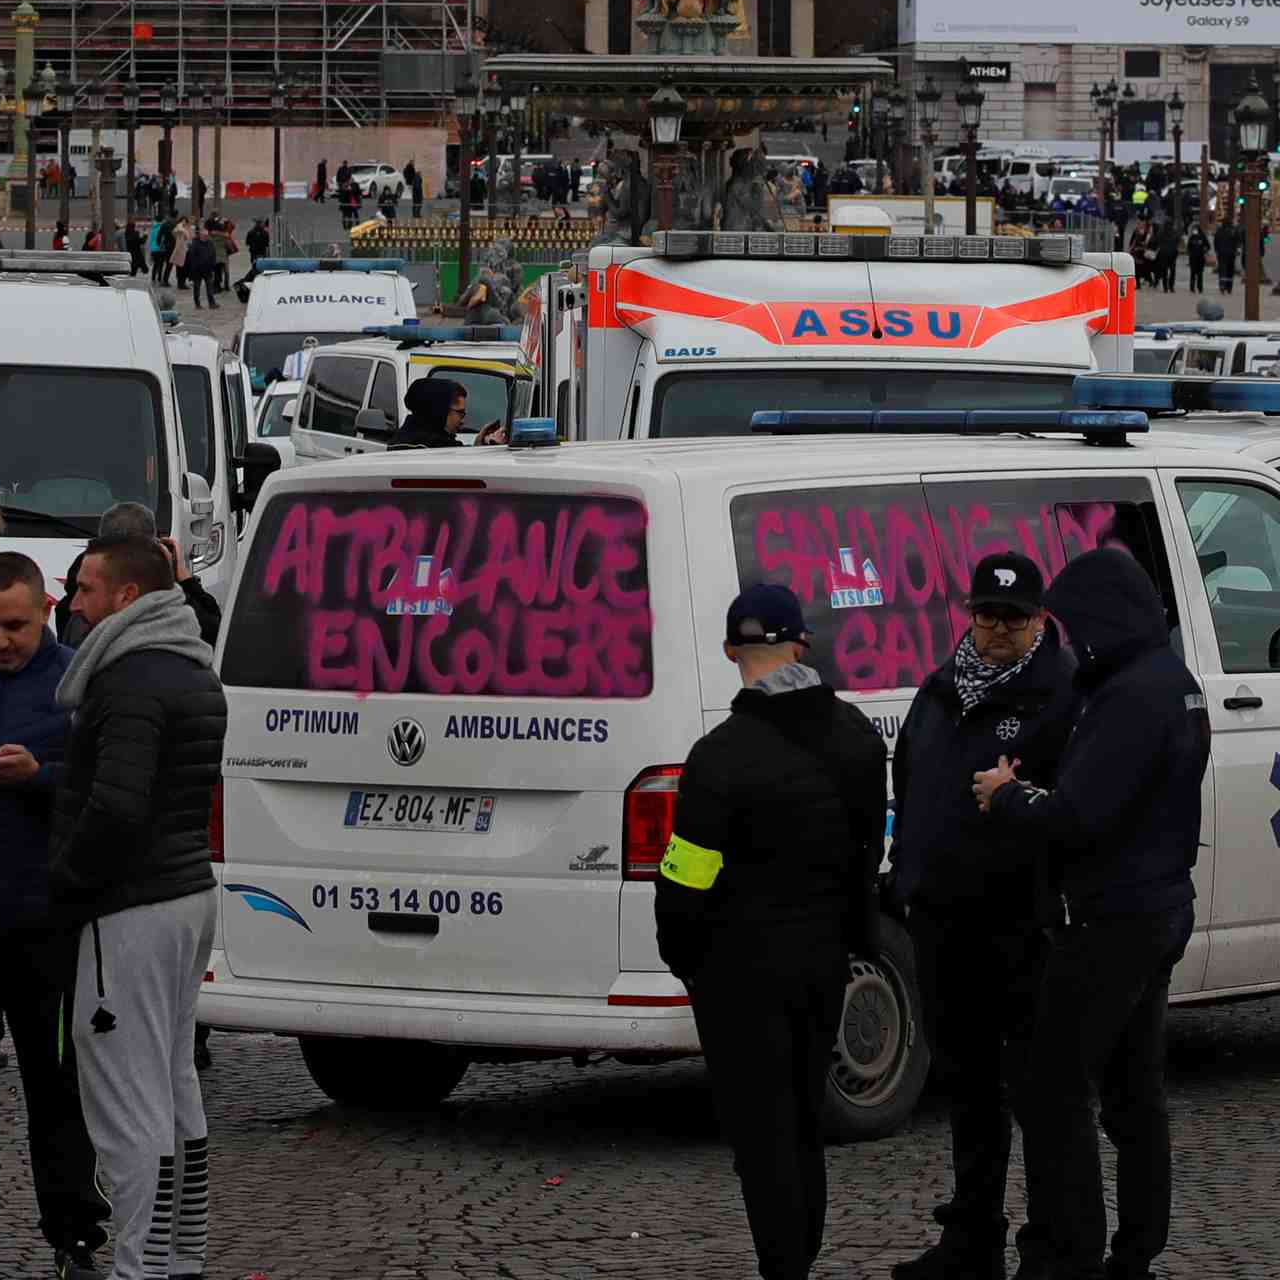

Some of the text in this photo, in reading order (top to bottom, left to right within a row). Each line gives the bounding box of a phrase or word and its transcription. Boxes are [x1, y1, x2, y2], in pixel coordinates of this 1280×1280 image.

[1186, 15, 1250, 29] Galaxy S9
[969, 66, 1007, 77] ATHEM
[276, 294, 387, 306] AMBULANCE
[791, 308, 962, 339] ASSU
[664, 346, 717, 358] BAUS
[264, 708, 610, 744] OPTIMUM AMBULANCES
[358, 793, 476, 828] EZ-804-MF
[311, 884, 504, 915] 01 53 14 00 86
